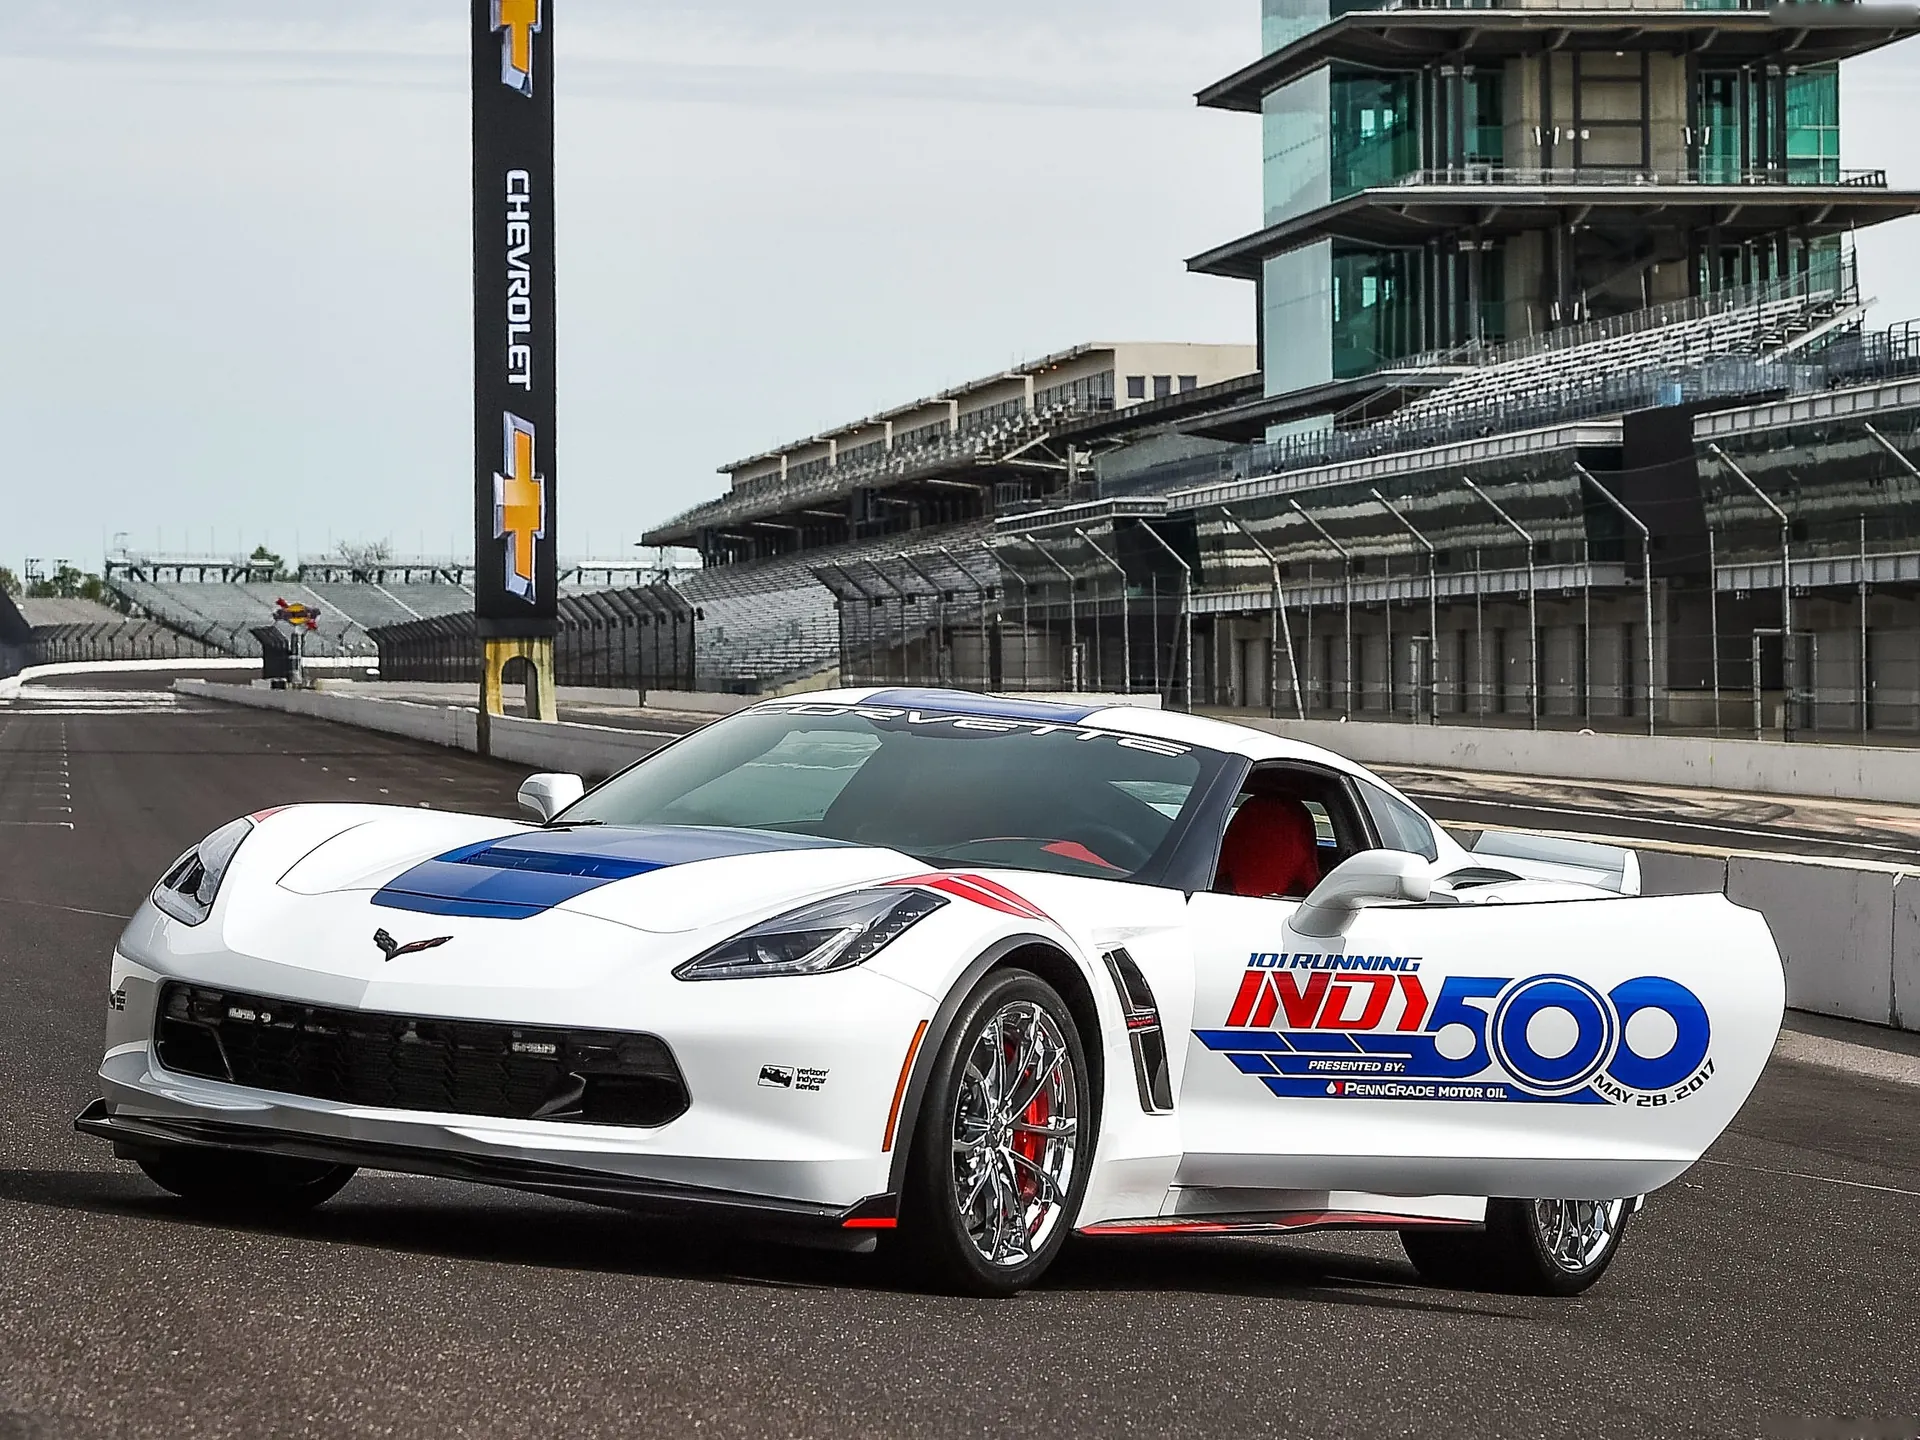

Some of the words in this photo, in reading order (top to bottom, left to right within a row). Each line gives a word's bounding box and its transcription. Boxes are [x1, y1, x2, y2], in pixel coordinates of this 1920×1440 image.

[506, 169, 531, 391] CHEVROLET
[1247, 952, 1289, 968] 101
[1289, 953, 1423, 972] RUNNING
[1225, 970, 1429, 1032] INDY
[1423, 973, 1711, 1091] 500
[1308, 1060, 1381, 1071] PRESENTED
[1383, 1062, 1406, 1072] BY:
[795, 1083, 820, 1091] series
[1438, 1086, 1483, 1098] MOTOR
[1486, 1088, 1507, 1099] OIL
[1593, 1074, 1634, 1104] MAY
